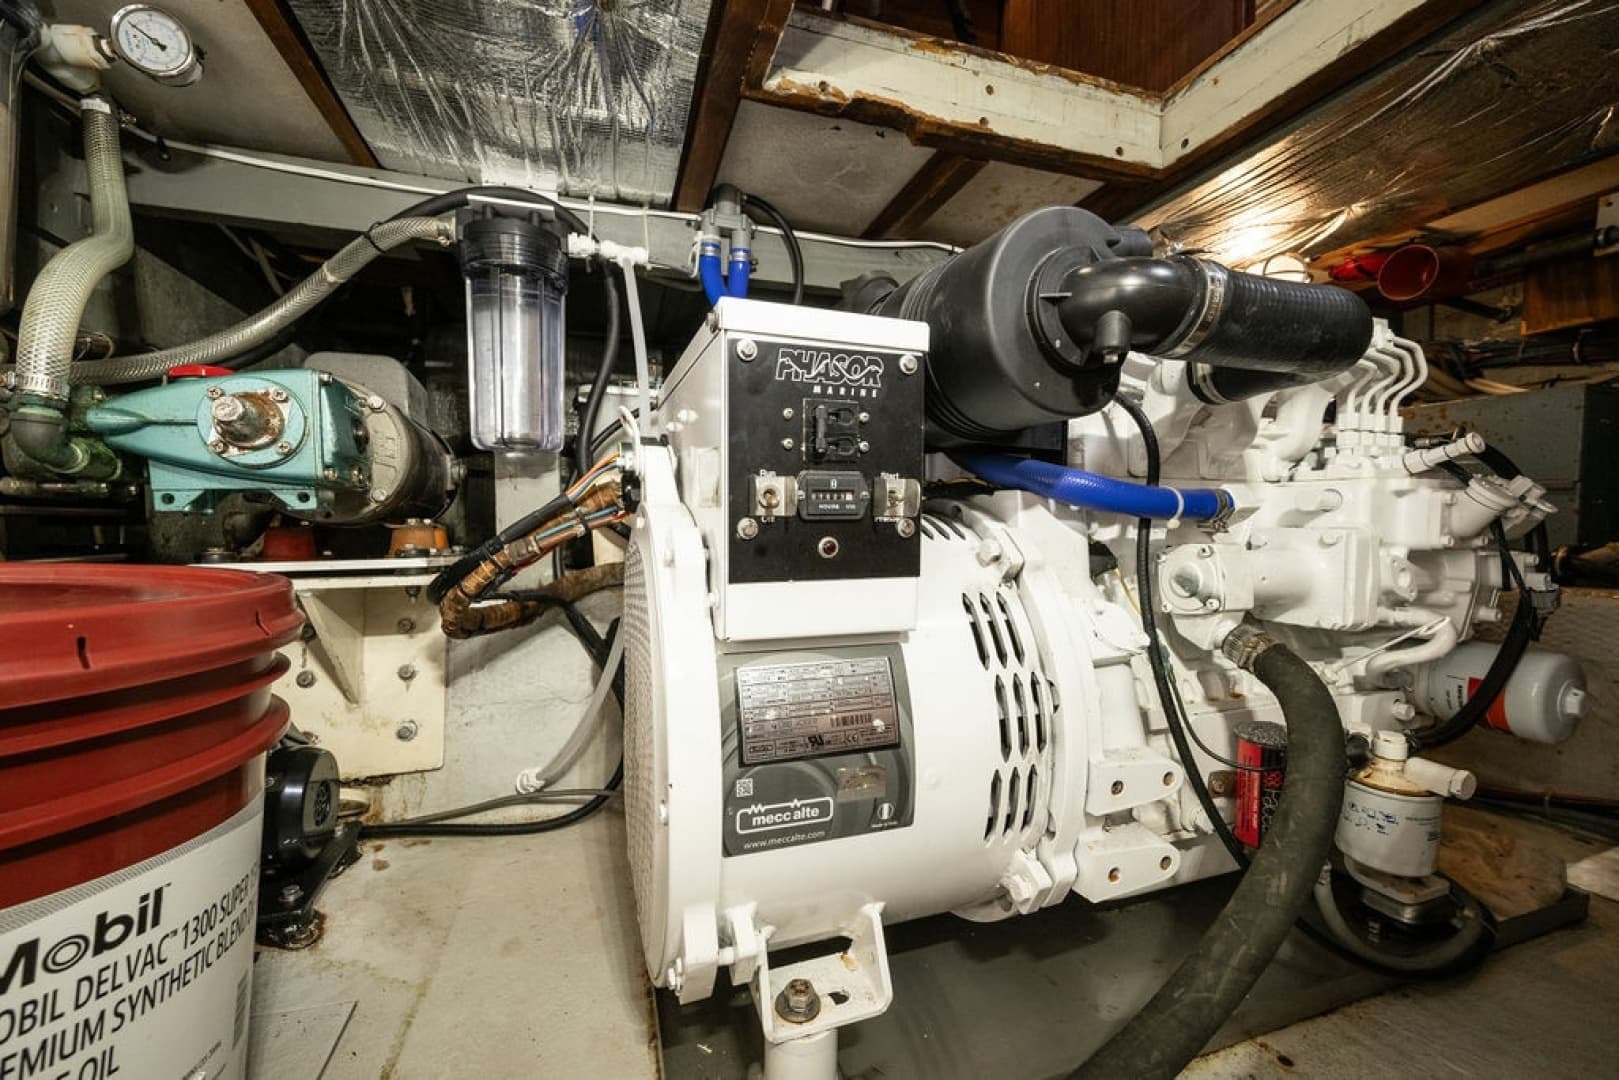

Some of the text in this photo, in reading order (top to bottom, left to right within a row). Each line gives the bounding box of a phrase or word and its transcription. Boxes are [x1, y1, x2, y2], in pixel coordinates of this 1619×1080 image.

[776, 348, 884, 388] PHASOR
[813, 385, 877, 398] MARINE
[744, 830, 826, 850] www.meccalte.com
[182, 903, 217, 949] 1300
[219, 874, 249, 924] SUPER
[111, 939, 214, 1034] SYNTHETIC
[78, 1045, 120, 1080] OIL
